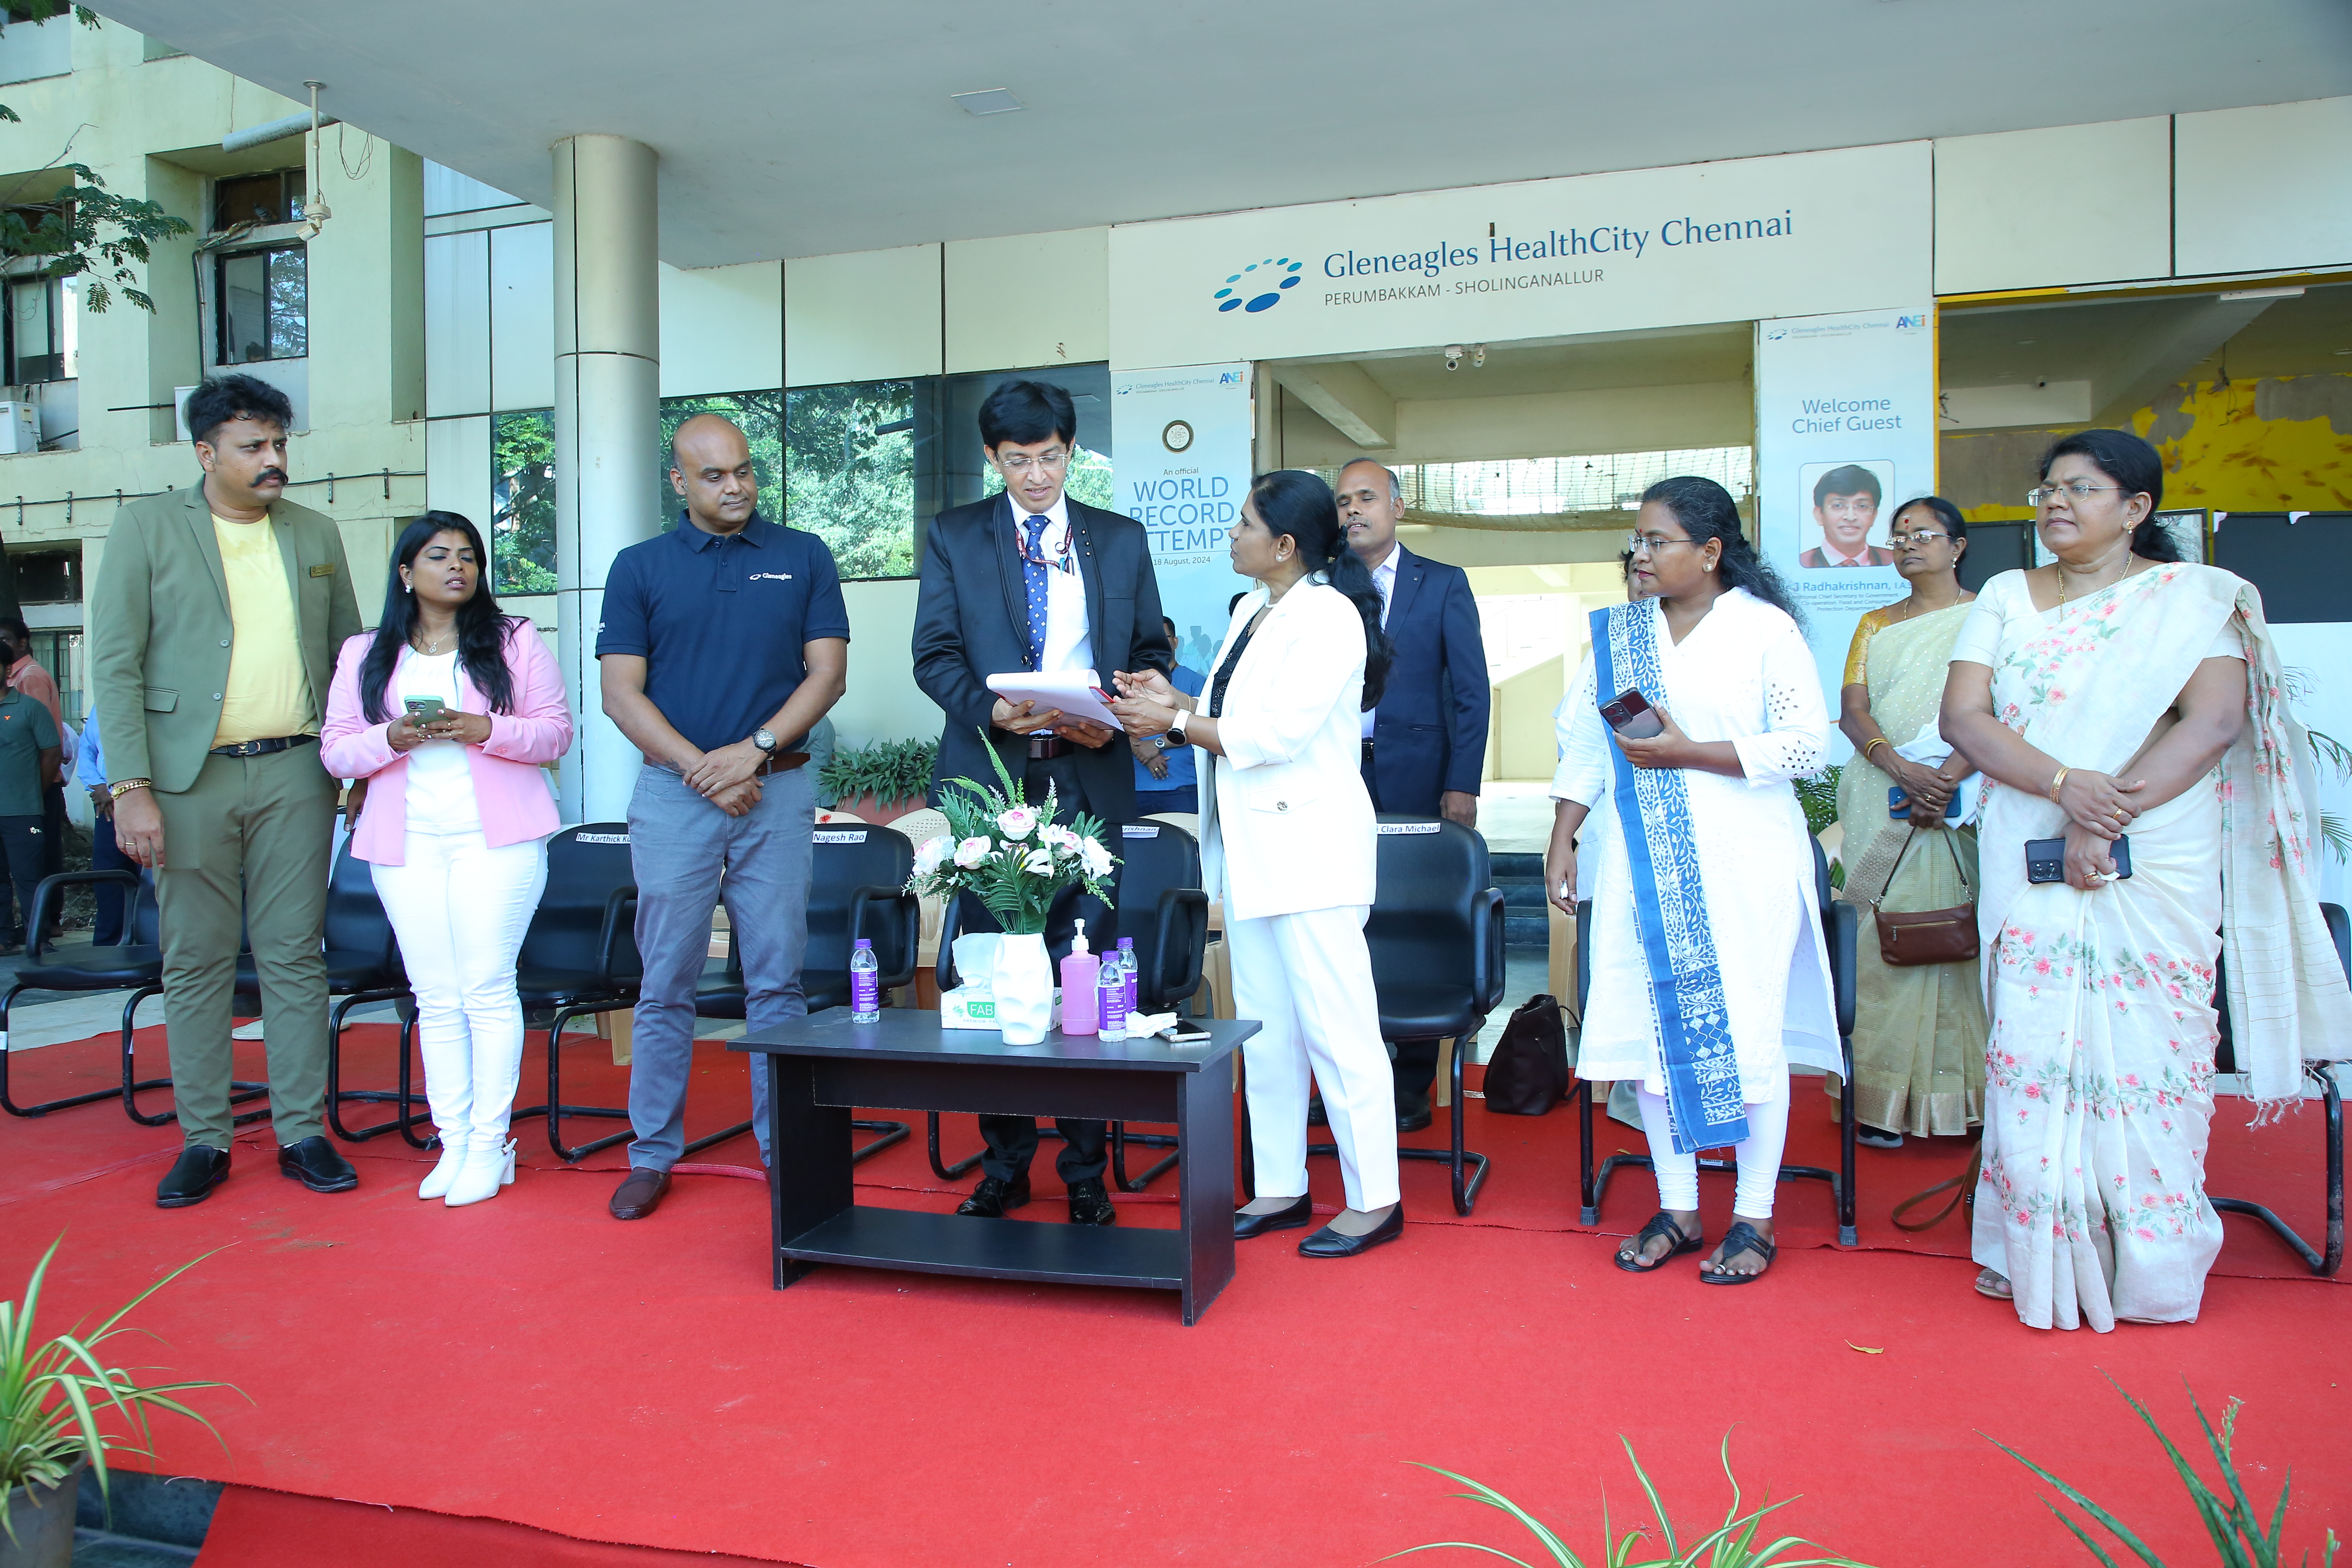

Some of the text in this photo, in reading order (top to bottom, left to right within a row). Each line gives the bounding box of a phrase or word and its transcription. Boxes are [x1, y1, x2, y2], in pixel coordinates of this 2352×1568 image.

[1324, 209, 1792, 277] Gleneagles HealthCity Chennai
[1325, 284, 1441, 305] PERUMBAKKAM
[1455, 269, 1604, 294] SHOLINGANALLUR
[1802, 399, 1891, 414] Welcome
[1792, 415, 1902, 434] Chief Guest
[1133, 477, 1229, 502] WORLD
[1130, 502, 1235, 527] RECORD
[1164, 557, 1190, 566] August,
[1803, 581, 1891, 591] Radhakrishnan,
[813, 833, 846, 843] Nagesh
